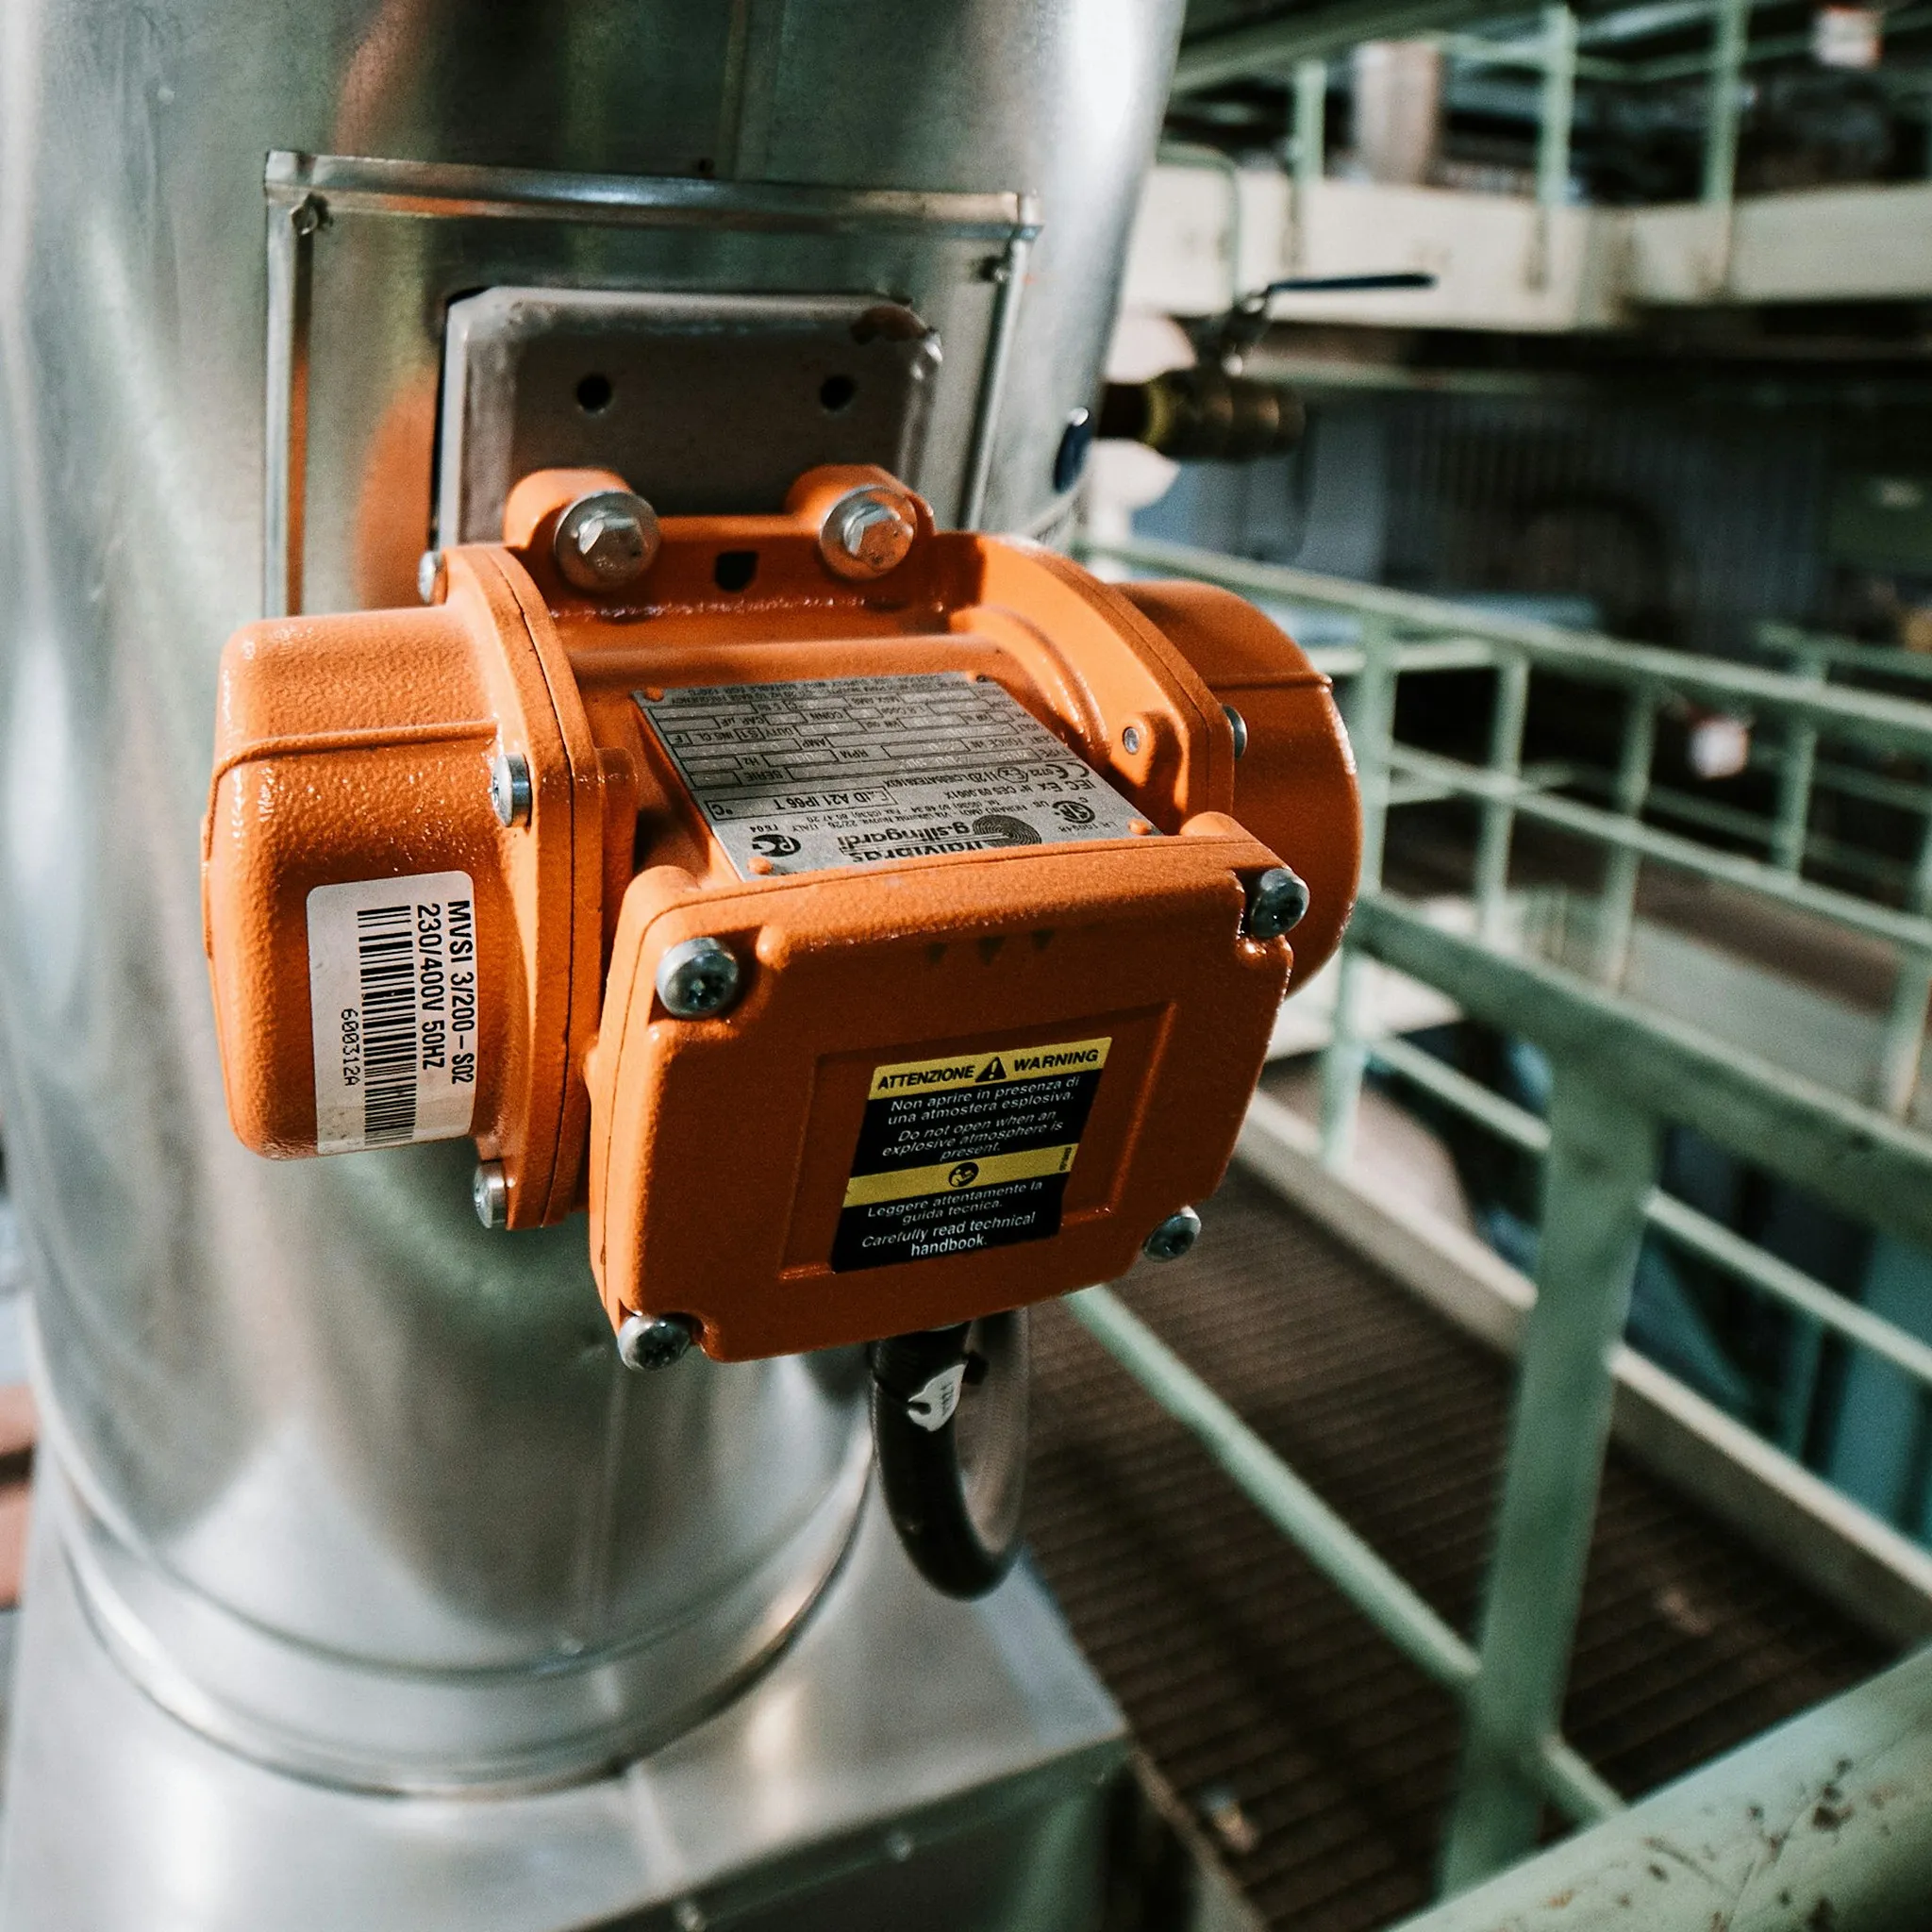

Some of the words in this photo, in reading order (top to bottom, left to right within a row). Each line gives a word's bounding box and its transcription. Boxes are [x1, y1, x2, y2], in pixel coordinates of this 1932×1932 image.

[742, 757, 758, 766] Hz
[743, 769, 782, 780] SERIE
[1038, 782, 1062, 792] Ex
[1063, 778, 1095, 791] IEC
[786, 795, 819, 808] IP66
[822, 792, 852, 806] A21
[836, 822, 971, 851] g.silingardi
[447, 899, 474, 963] MVSI
[416, 902, 445, 1012] 230/400V
[341, 1008, 361, 1087] 600312A
[422, 1019, 445, 1071] 50HZ
[1014, 1049, 1099, 1072] WARNING
[877, 1065, 976, 1091] ATTENZIONE
[891, 1099, 924, 1112] Non
[926, 1092, 973, 1108] aprire
[976, 1089, 991, 1100] in
[994, 1080, 1062, 1101] presenza
[1065, 1075, 1082, 1089] di
[888, 1113, 917, 1125] una
[921, 1102, 998, 1121] atmosfera
[1001, 1091, 1075, 1109] esplosiva.
[881, 1137, 957, 1158] explosive
[958, 1123, 1048, 1145] atmosphere
[1050, 1120, 1065, 1132] is
[897, 1129, 921, 1142] Do
[924, 1124, 951, 1139] not
[952, 1120, 992, 1135] open
[995, 1113, 1036, 1127] when
[1037, 1110, 1057, 1123] an
[939, 1141, 1001, 1163] present.
[867, 1199, 929, 1220] Leggere
[931, 1184, 1027, 1208] attentamente
[1029, 1180, 1043, 1192] la
[902, 1208, 944, 1227] guida
[947, 1199, 1004, 1218] tecnica.
[860, 1227, 928, 1248] Carefully
[931, 1221, 967, 1238] read
[968, 1210, 1037, 1233] technical
[909, 1233, 988, 1257] handbook.
